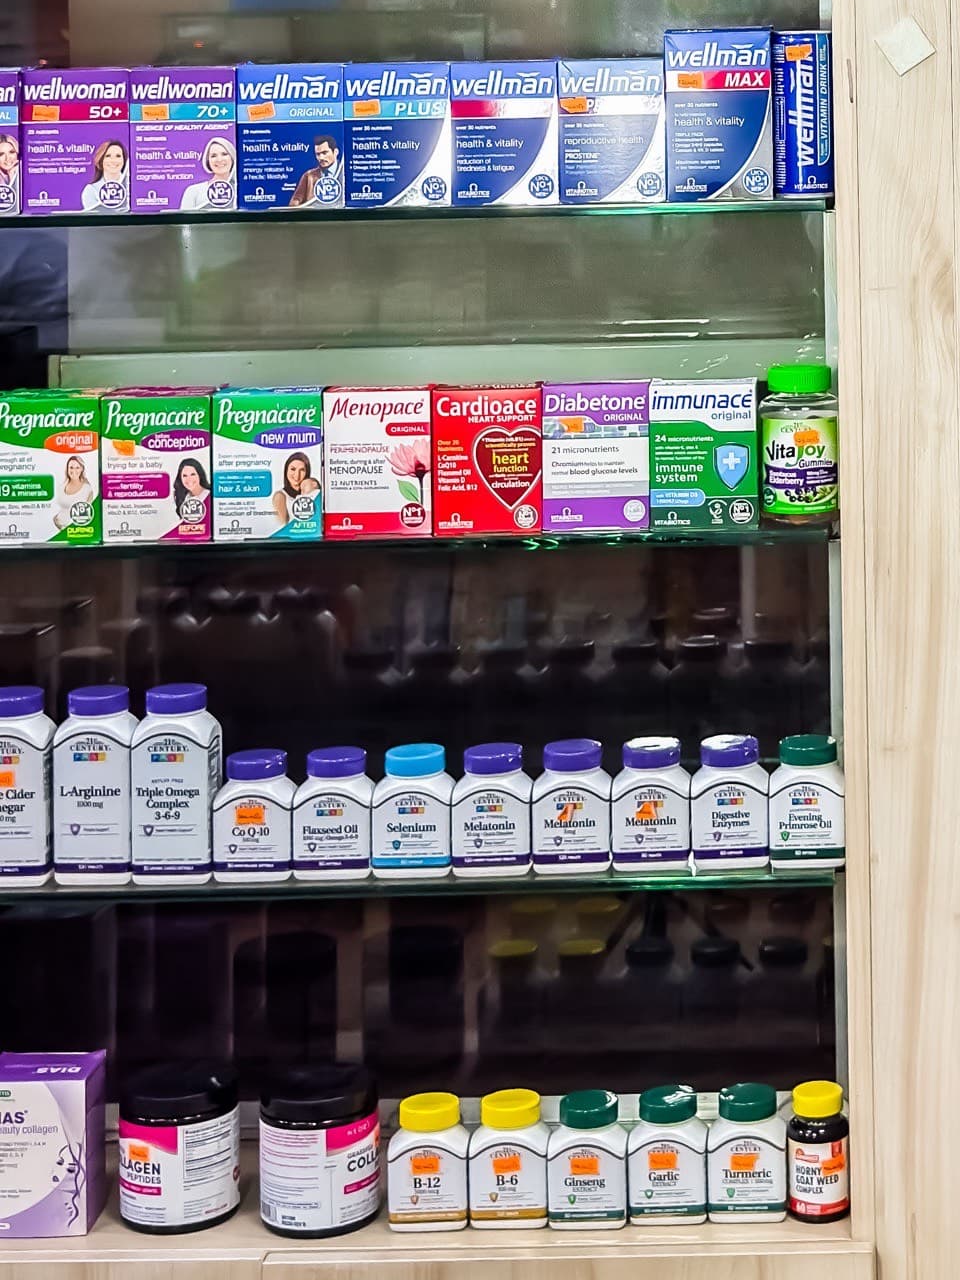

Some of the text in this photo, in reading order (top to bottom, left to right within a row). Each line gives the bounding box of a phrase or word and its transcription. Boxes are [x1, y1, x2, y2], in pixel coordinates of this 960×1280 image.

[724, 72, 765, 87] MAX
[24, 77, 126, 101] wellwoman
[132, 77, 233, 100] wellwoman
[89, 106, 122, 118] 50+
[197, 106, 228, 118] 70+
[290, 108, 335, 117] ORIGINAL
[395, 102, 442, 116] PLUS
[436, 397, 537, 417] Cardioace
[544, 394, 646, 413] Diabetone
[652, 391, 752, 411] immunace
[330, 398, 423, 421] Menopace
[105, 403, 205, 435] Pregnacare
[468, 414, 536, 424] HEART SUPPORT
[711, 411, 751, 422] original
[148, 436, 205, 451] conception
[260, 431, 317, 445] new mum
[552, 444, 619, 454] 21 micronutrients
[492, 452, 529, 465] heart
[799, 459, 832, 468] Gummies
[330, 466, 383, 474] MENOPAUSE
[494, 464, 528, 473] function
[655, 462, 704, 473] immune
[655, 473, 698, 484] system
[60, 785, 121, 799] L-Arginine
[136, 786, 200, 799] Triple Omega
[145, 798, 190, 810] Complex
[154, 810, 180, 820] 3-6-9
[712, 810, 750, 822] Digestive
[303, 824, 358, 834] Flaxseed Oil
[387, 823, 436, 832] Selenium
[464, 820, 516, 831] Melatonin
[723, 1169, 772, 1180] Turmeric
[795, 1165, 822, 1176] HORNY
[127, 1173, 161, 1184] PEPTIDES
[413, 1177, 441, 1188] B-12
[564, 1177, 605, 1189] Ginseng
[648, 1171, 680, 1183] Garlic
[795, 1174, 839, 1185] GOAT WEED
